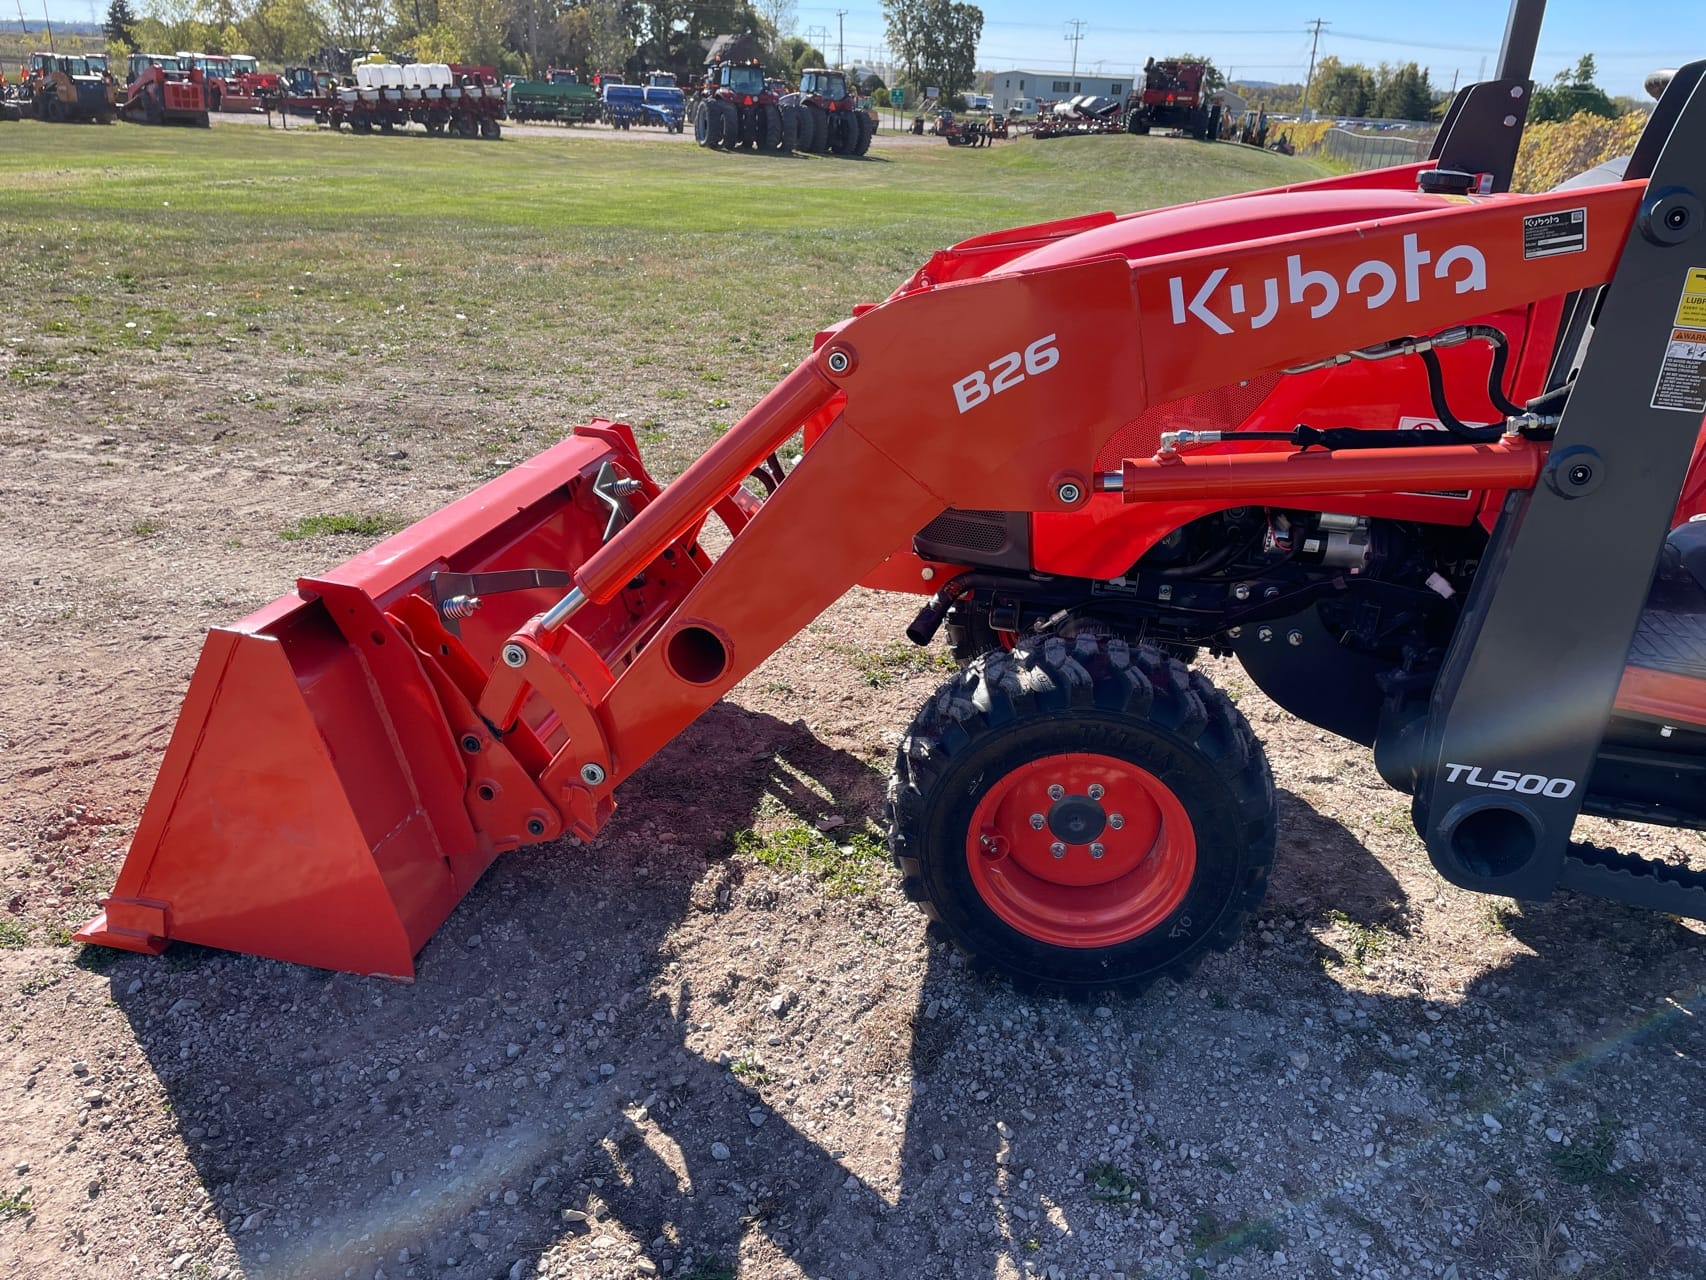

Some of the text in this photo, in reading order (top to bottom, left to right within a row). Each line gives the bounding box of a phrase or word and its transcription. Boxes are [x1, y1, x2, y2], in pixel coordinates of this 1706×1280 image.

[1525, 215, 1559, 227] Kubota
[1169, 232, 1487, 335] Kubota
[952, 333, 1060, 414] B26
[1445, 762, 1576, 799] TL500
